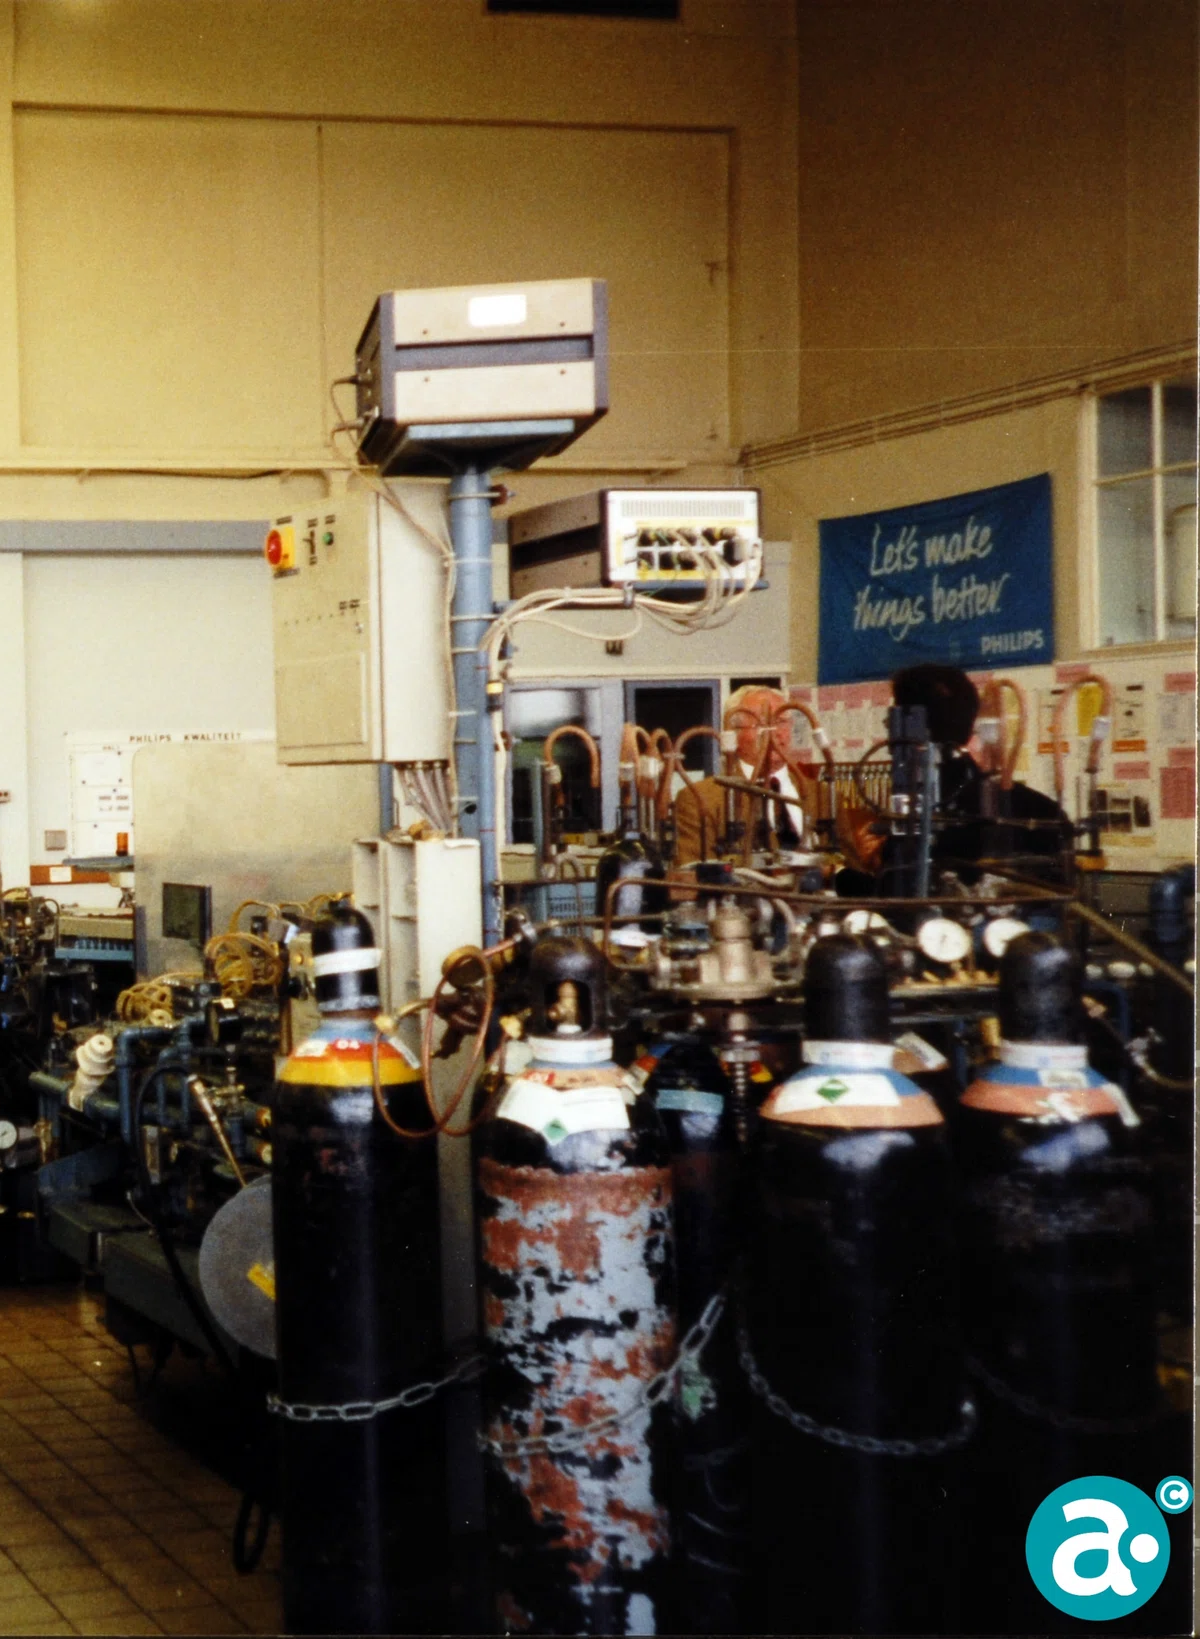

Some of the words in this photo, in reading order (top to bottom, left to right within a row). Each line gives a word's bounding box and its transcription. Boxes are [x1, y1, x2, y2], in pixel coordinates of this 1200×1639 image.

[870, 523, 919, 576] Let's
[925, 516, 993, 567] make
[854, 585, 926, 641] things
[980, 628, 1045, 655] PHILIPS
[130, 734, 172, 743] PHILIPS
[184, 732, 242, 742] KWALITEIT
